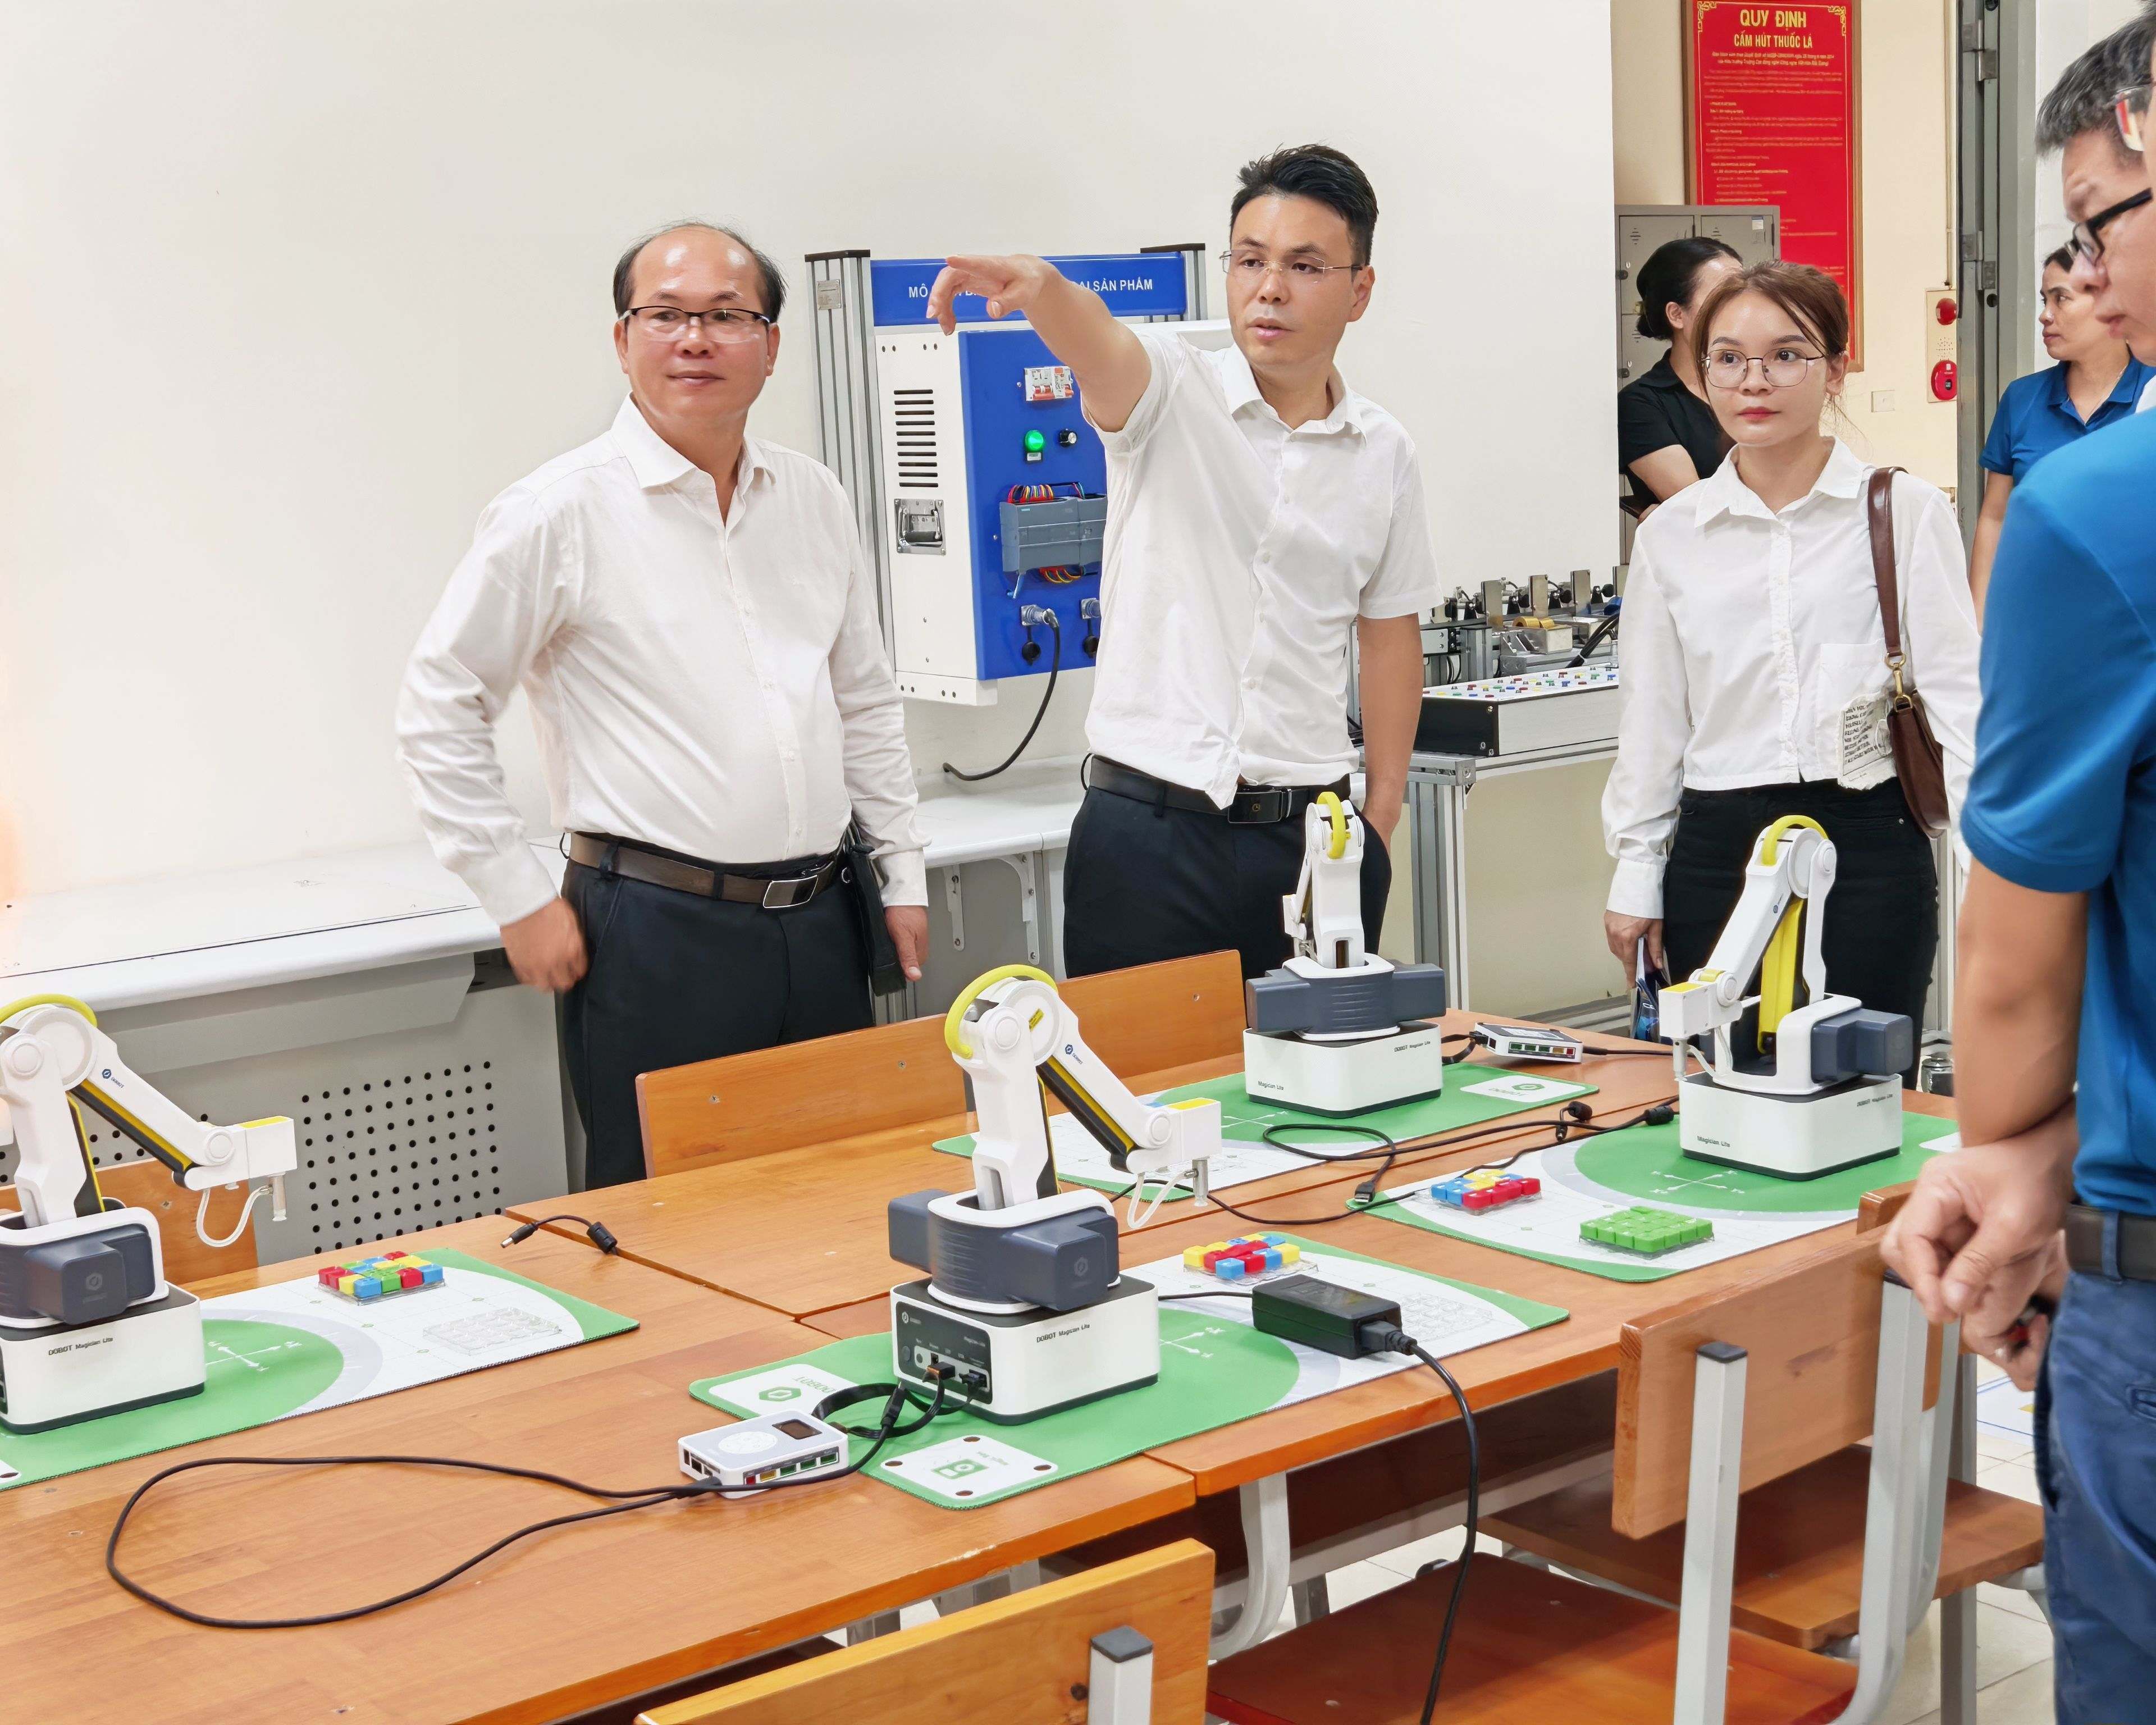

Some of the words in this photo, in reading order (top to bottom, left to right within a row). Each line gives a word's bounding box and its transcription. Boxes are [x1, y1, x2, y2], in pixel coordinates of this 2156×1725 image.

[1741, 9, 1769, 26] QUY
[1775, 10, 1806, 31] ĐỊNH
[1734, 30, 1752, 47] CẤM
[1755, 32, 1771, 47] HÚT
[1773, 31, 1801, 48] THUỐC
[1803, 34, 1813, 48] LÁ
[908, 284, 928, 298] MÔ
[1036, 1332, 1056, 1343] DOBOT
[48, 1344, 72, 1355] DOBOT
[75, 1340, 101, 1349] Magician
